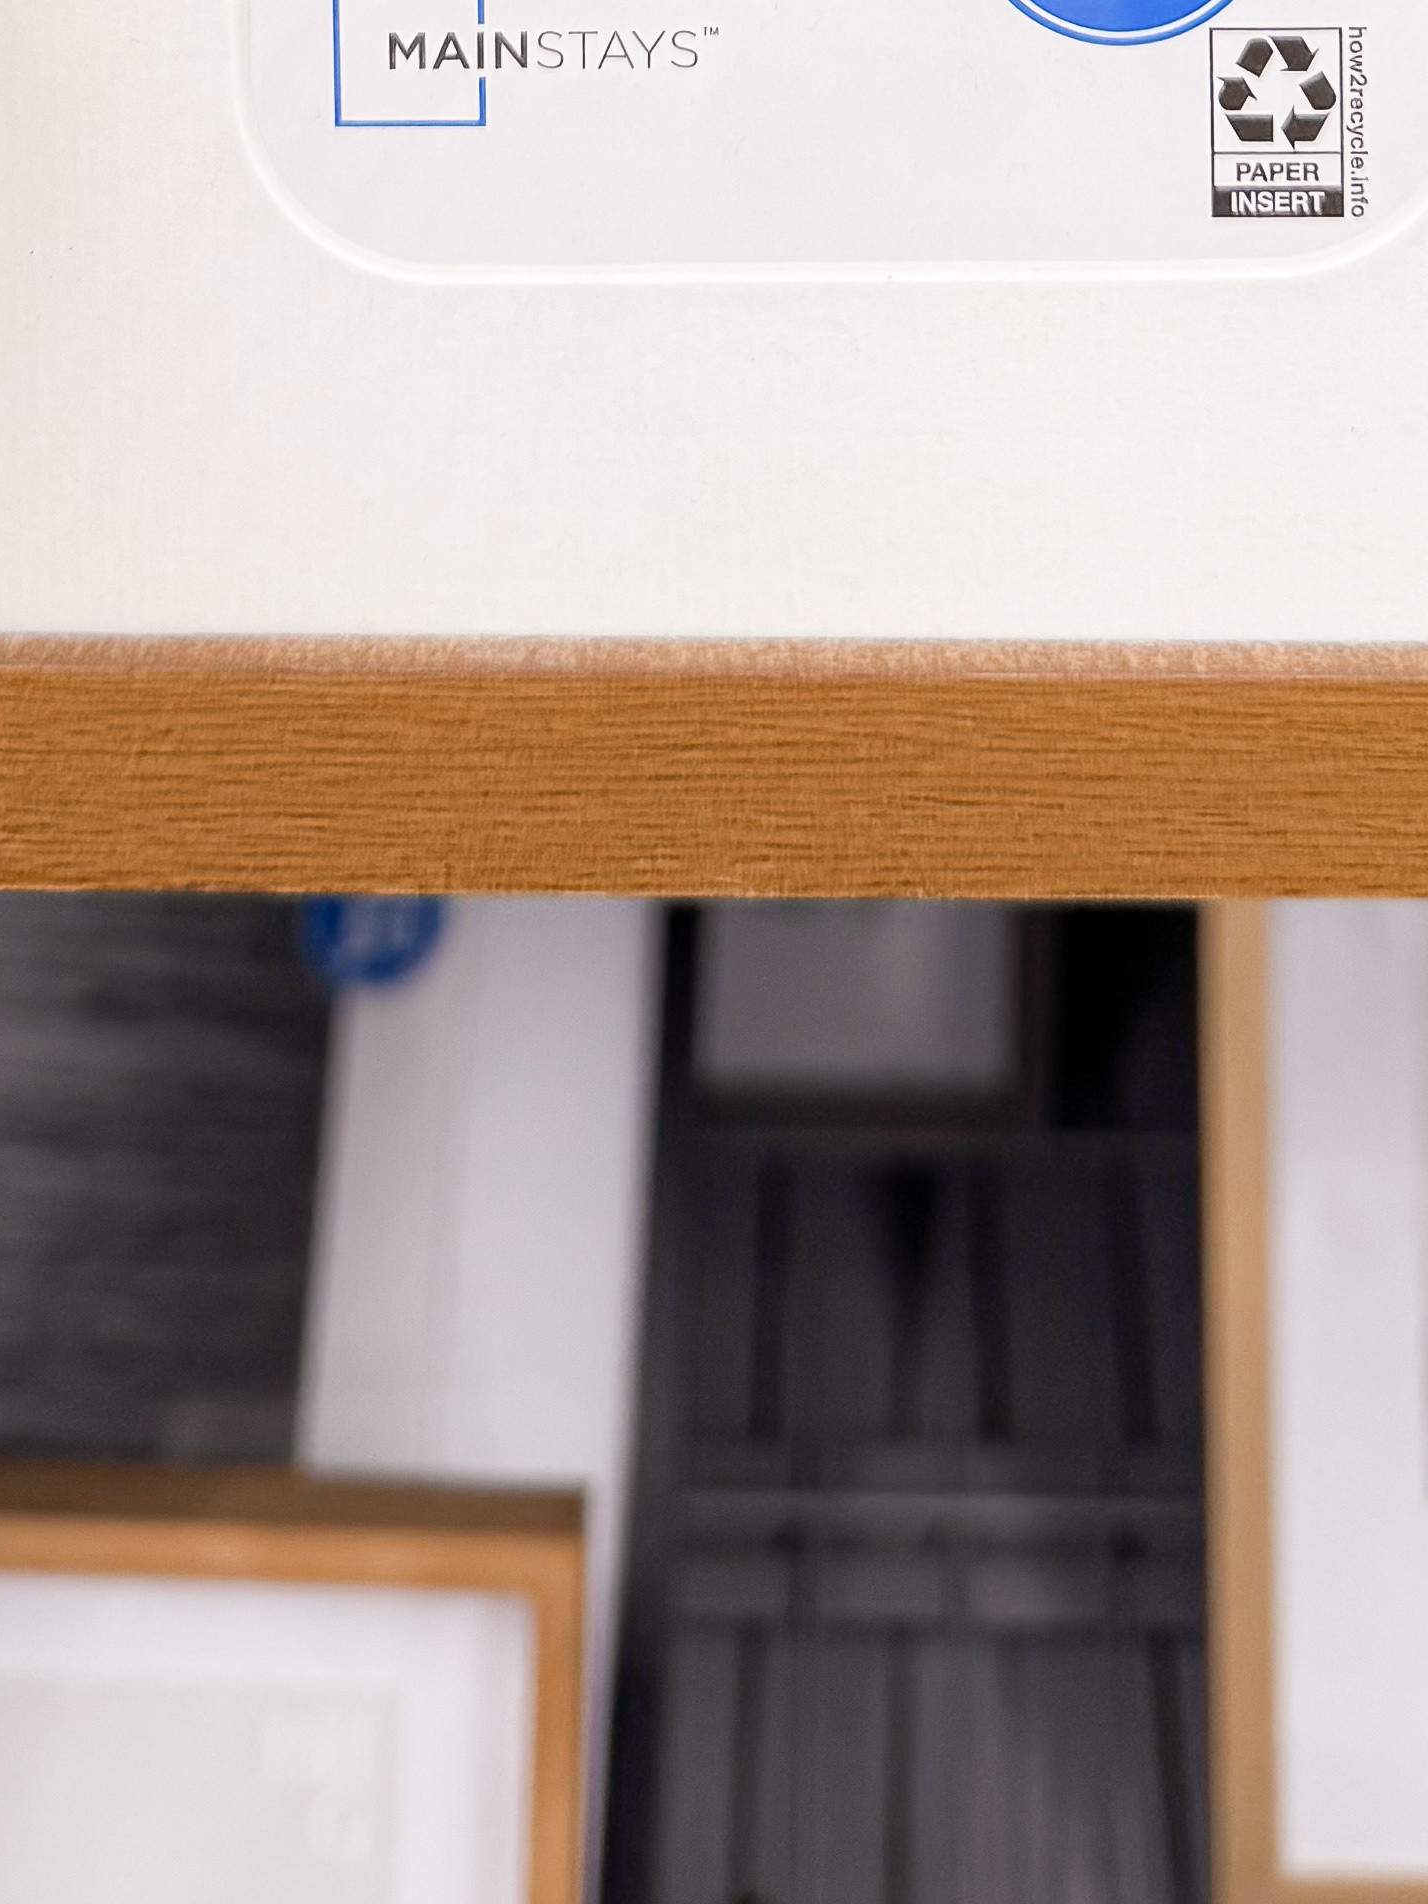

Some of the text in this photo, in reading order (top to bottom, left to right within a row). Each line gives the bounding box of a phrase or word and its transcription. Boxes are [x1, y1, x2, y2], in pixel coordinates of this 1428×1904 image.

[1345, 26, 1369, 218] how2recycle.info
[1235, 162, 1320, 183] PAPER
[1229, 191, 1326, 214] INSERT
